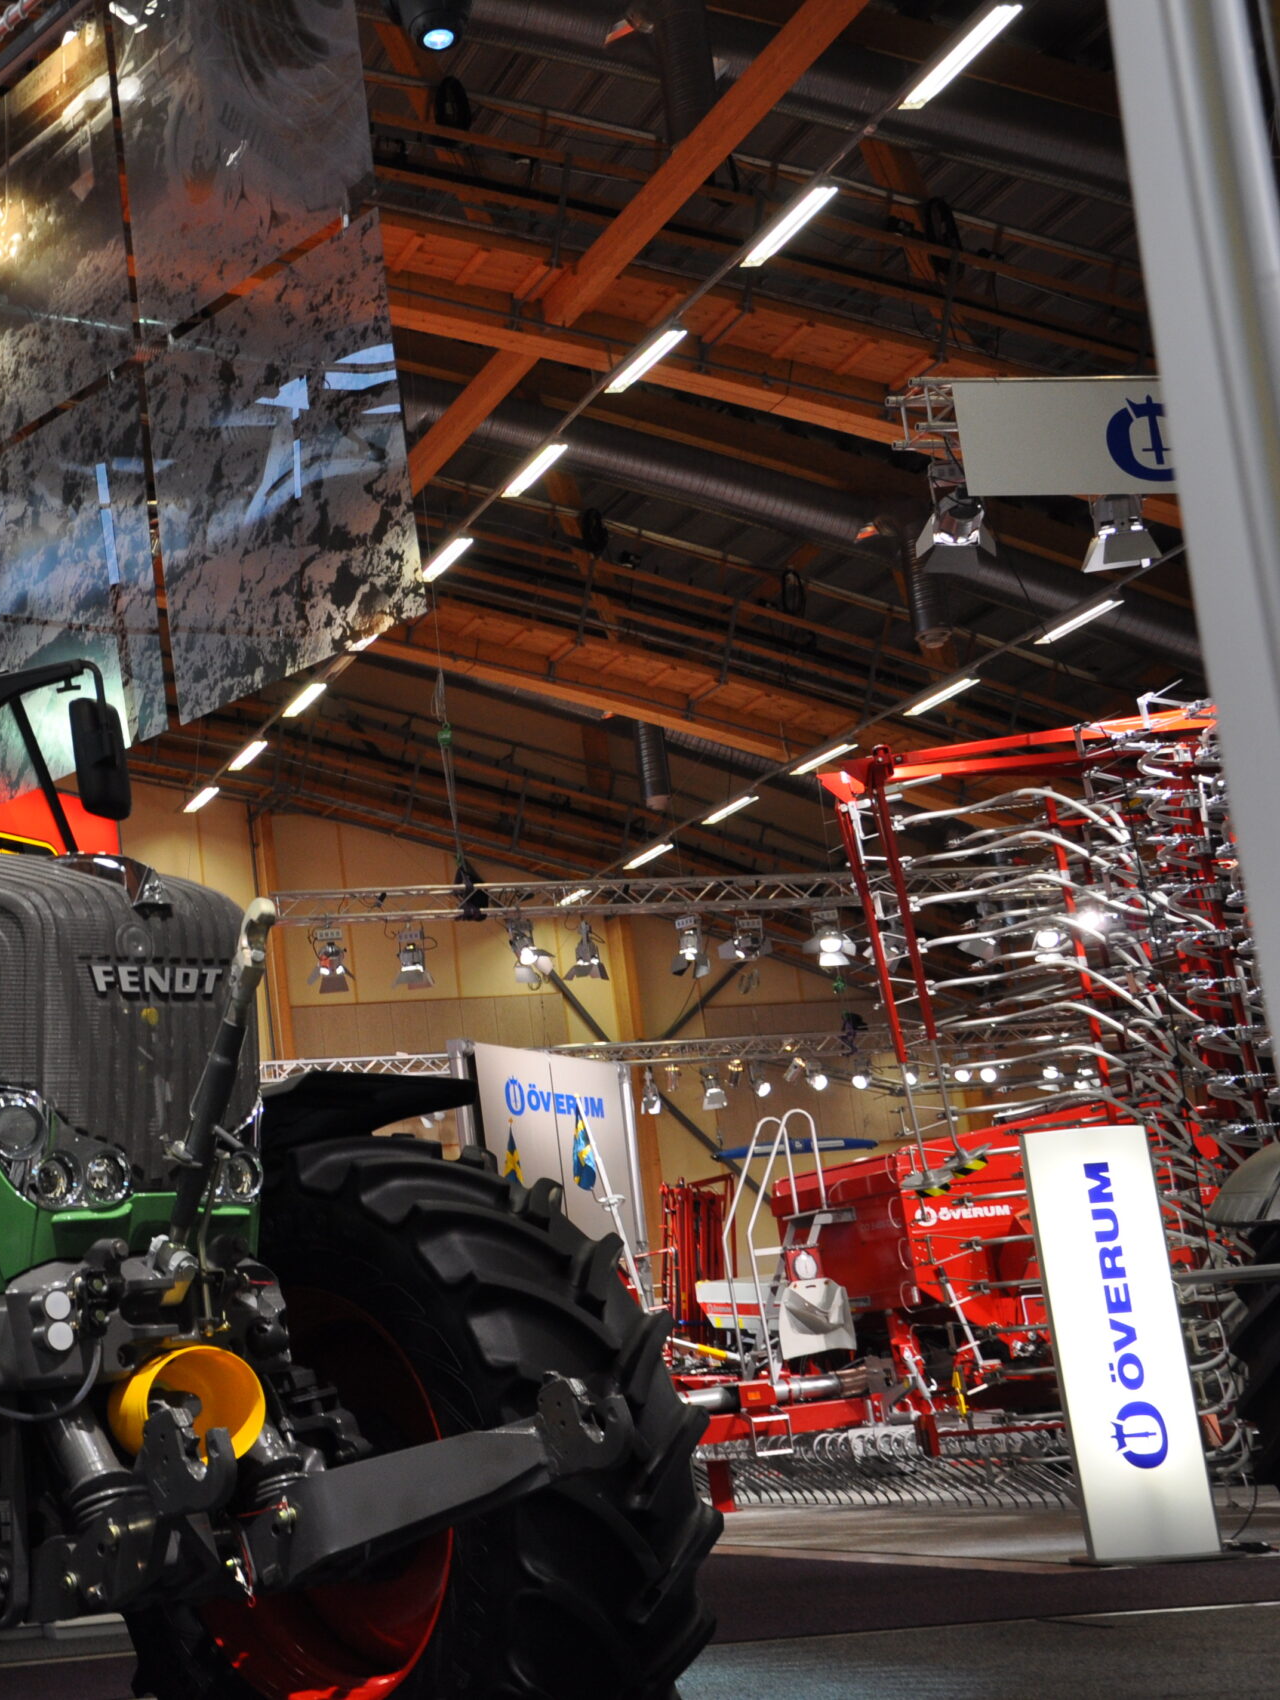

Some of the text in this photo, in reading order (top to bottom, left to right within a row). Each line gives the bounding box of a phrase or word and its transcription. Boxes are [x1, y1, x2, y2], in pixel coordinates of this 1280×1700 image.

[91, 965, 223, 995] FENDT
[938, 1205, 1011, 1221] ÖVERUM
[1083, 1162, 1145, 1390] ÖVERUM
